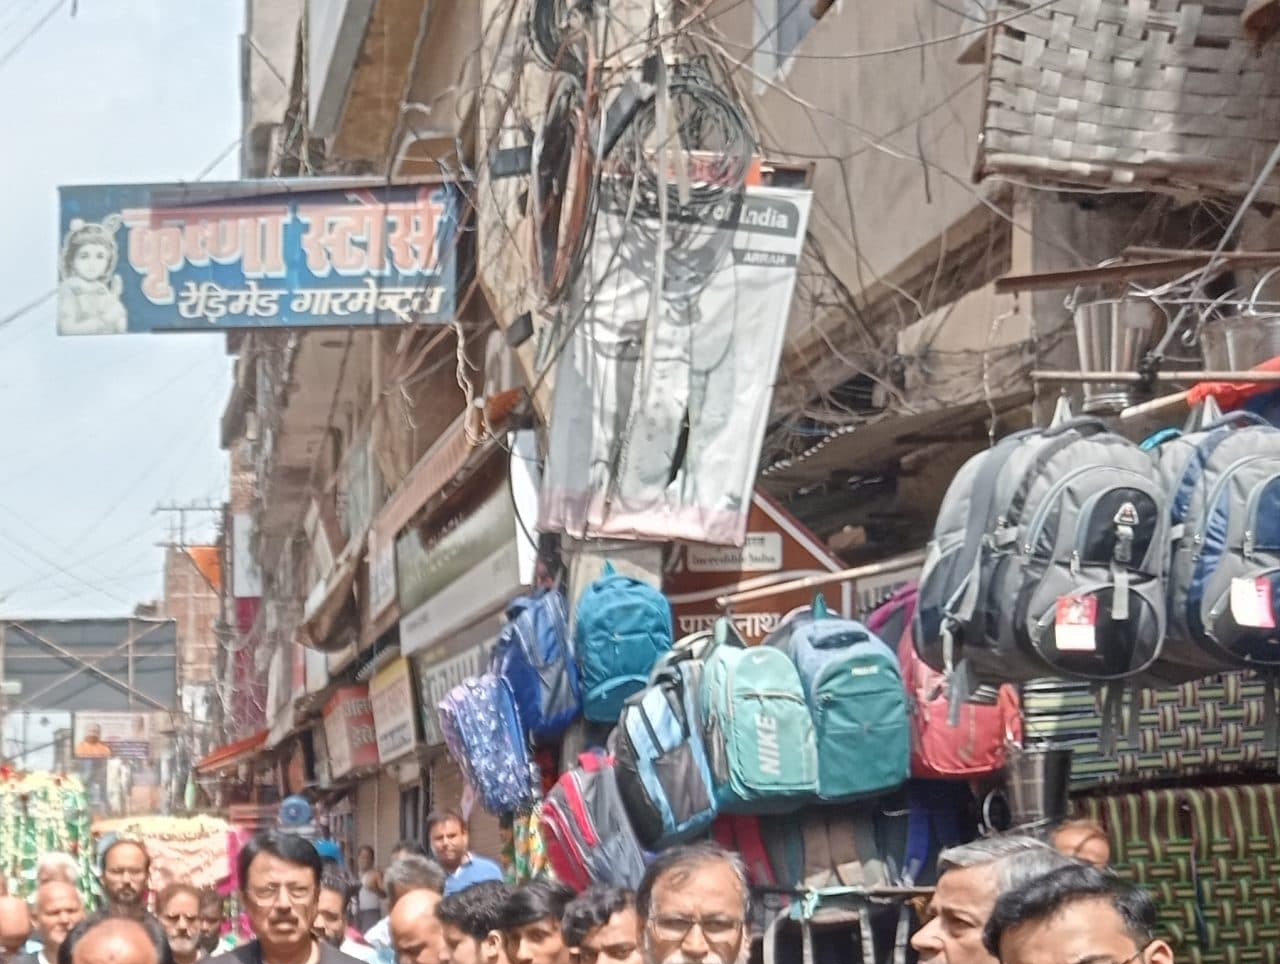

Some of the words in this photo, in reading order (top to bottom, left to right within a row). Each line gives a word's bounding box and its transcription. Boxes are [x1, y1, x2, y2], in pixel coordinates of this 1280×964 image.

[738, 203, 789, 229] India
[121, 204, 290, 306] कृष्णा
[754, 713, 782, 776] NIKE
